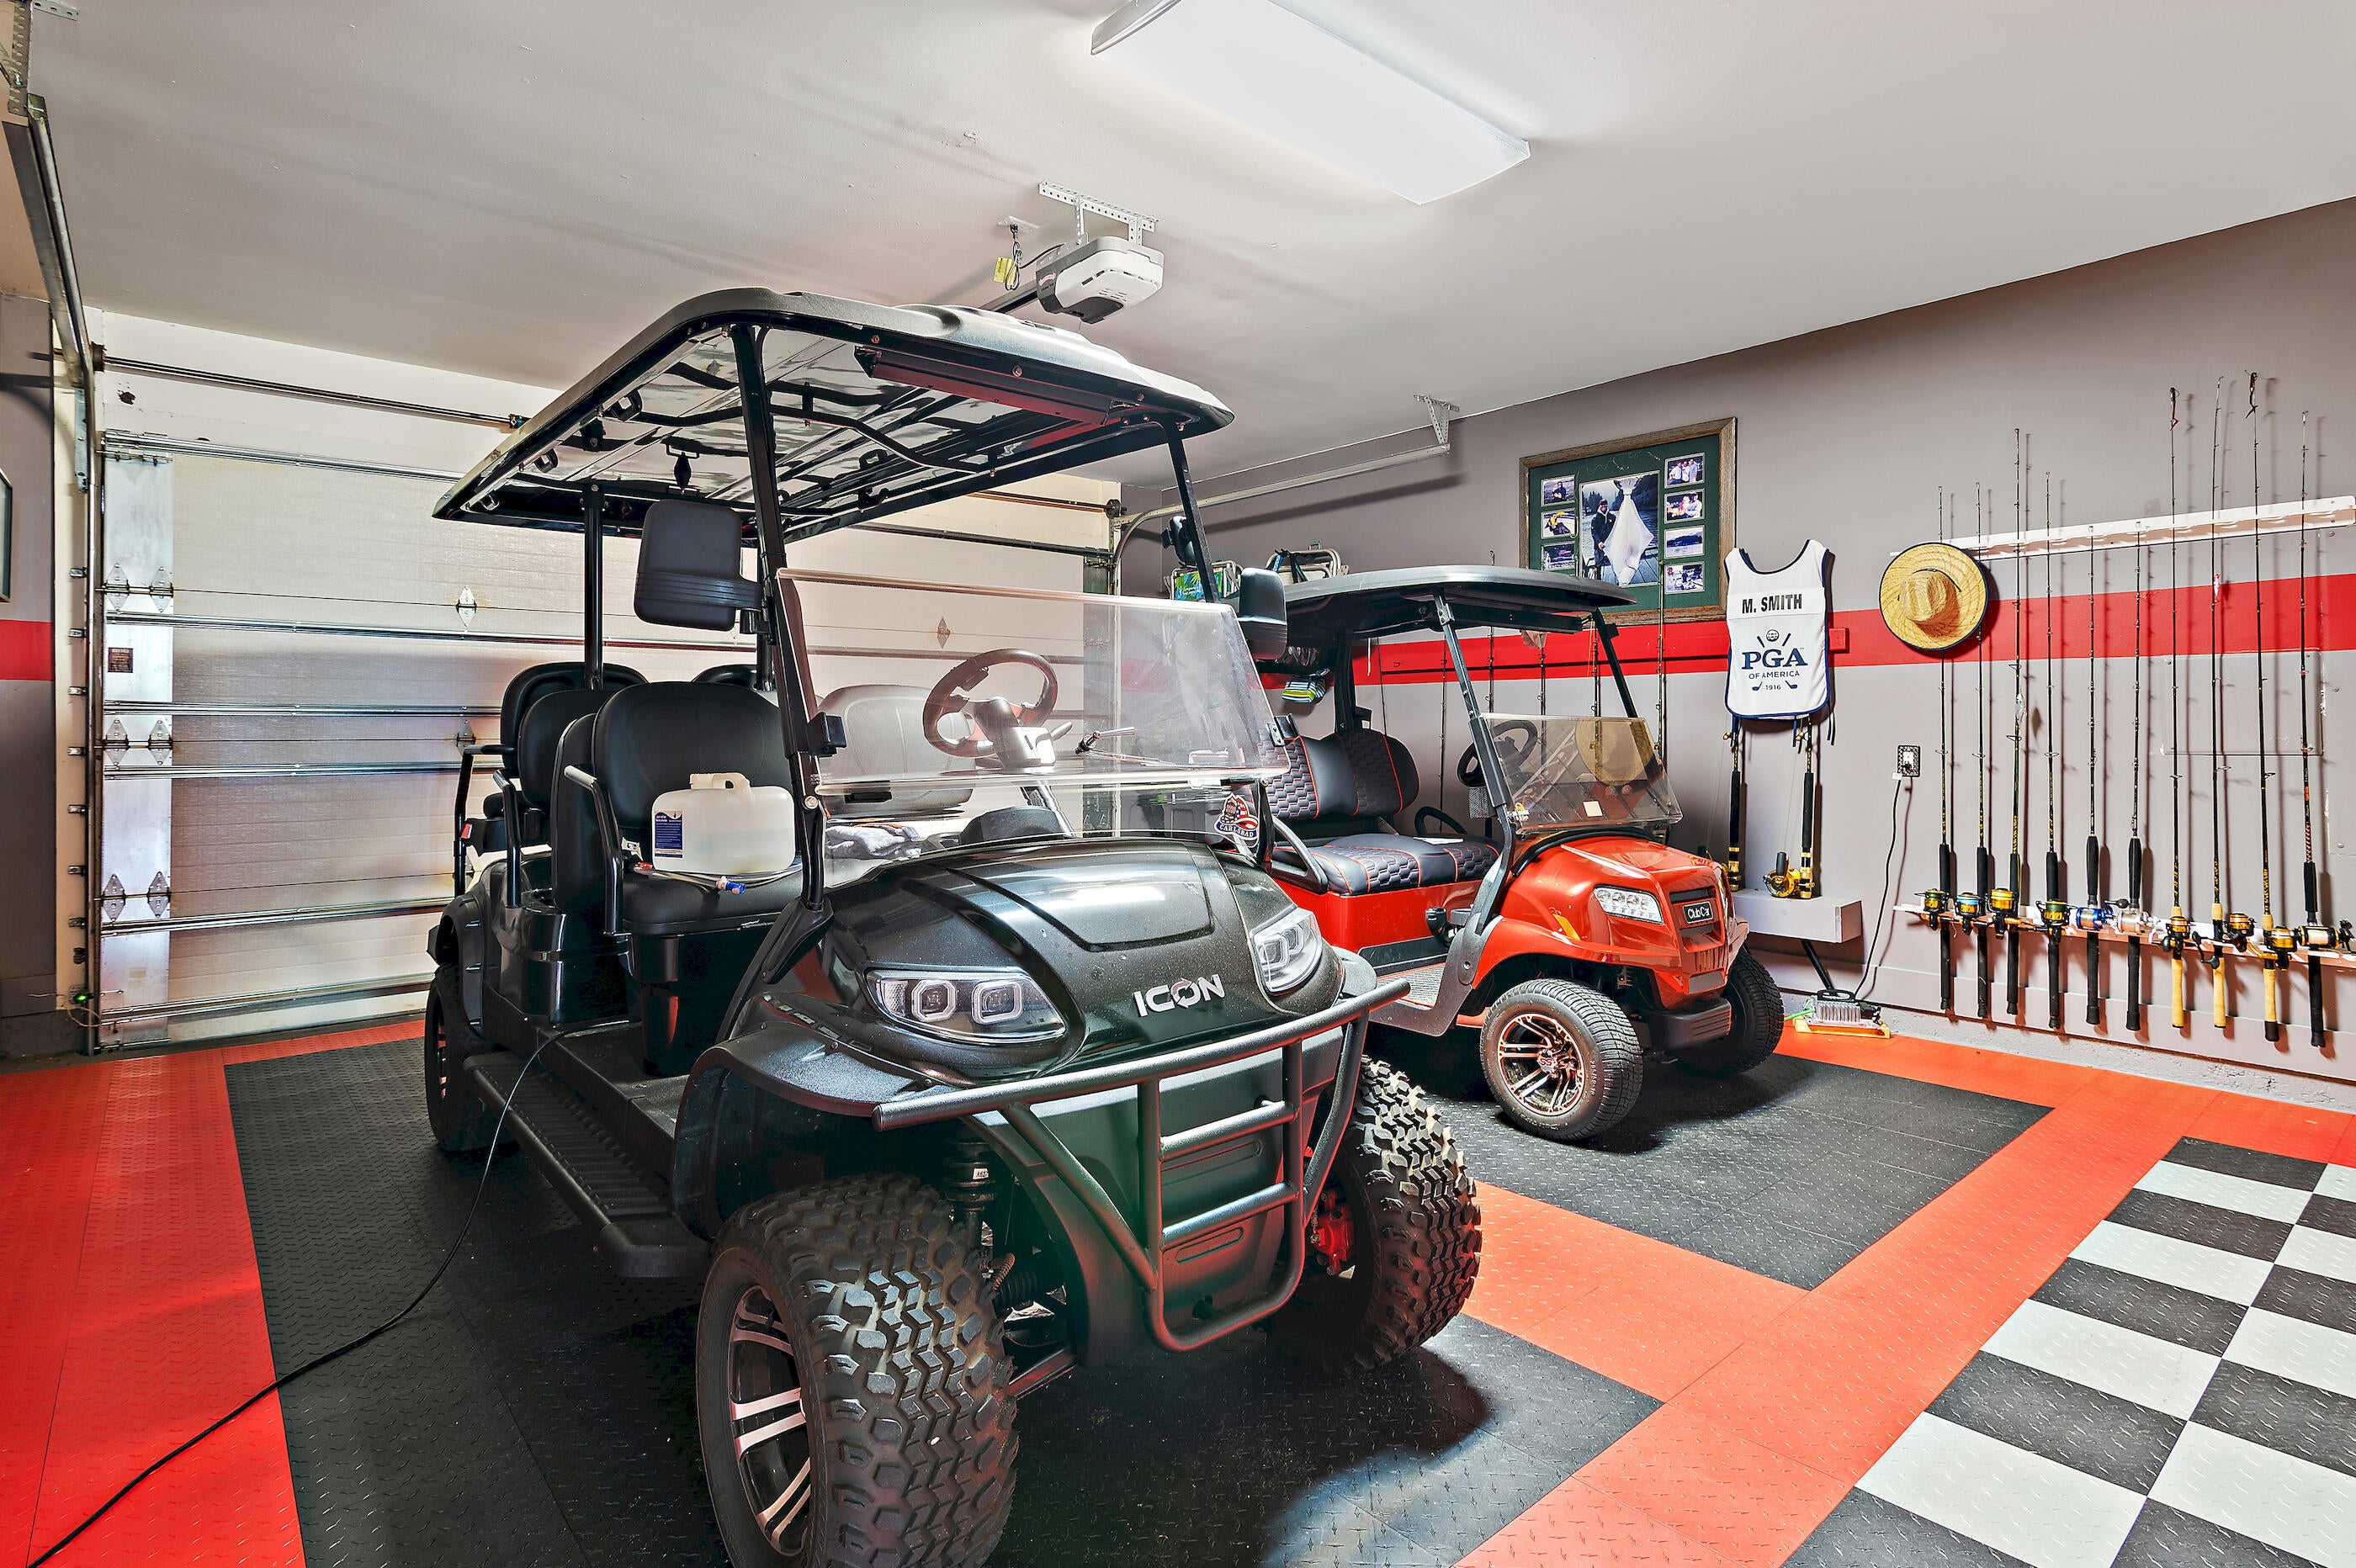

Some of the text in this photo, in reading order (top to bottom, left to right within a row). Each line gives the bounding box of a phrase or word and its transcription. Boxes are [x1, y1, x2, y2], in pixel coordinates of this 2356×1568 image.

[1742, 593, 1802, 614] M. SMITH
[1741, 648, 1808, 670] PGA
[1761, 670, 1801, 679] AMERICA
[1219, 824, 1255, 838] CARLSBAD
[1687, 908, 1701, 919] Club
[1133, 973, 1225, 1017] ICON
